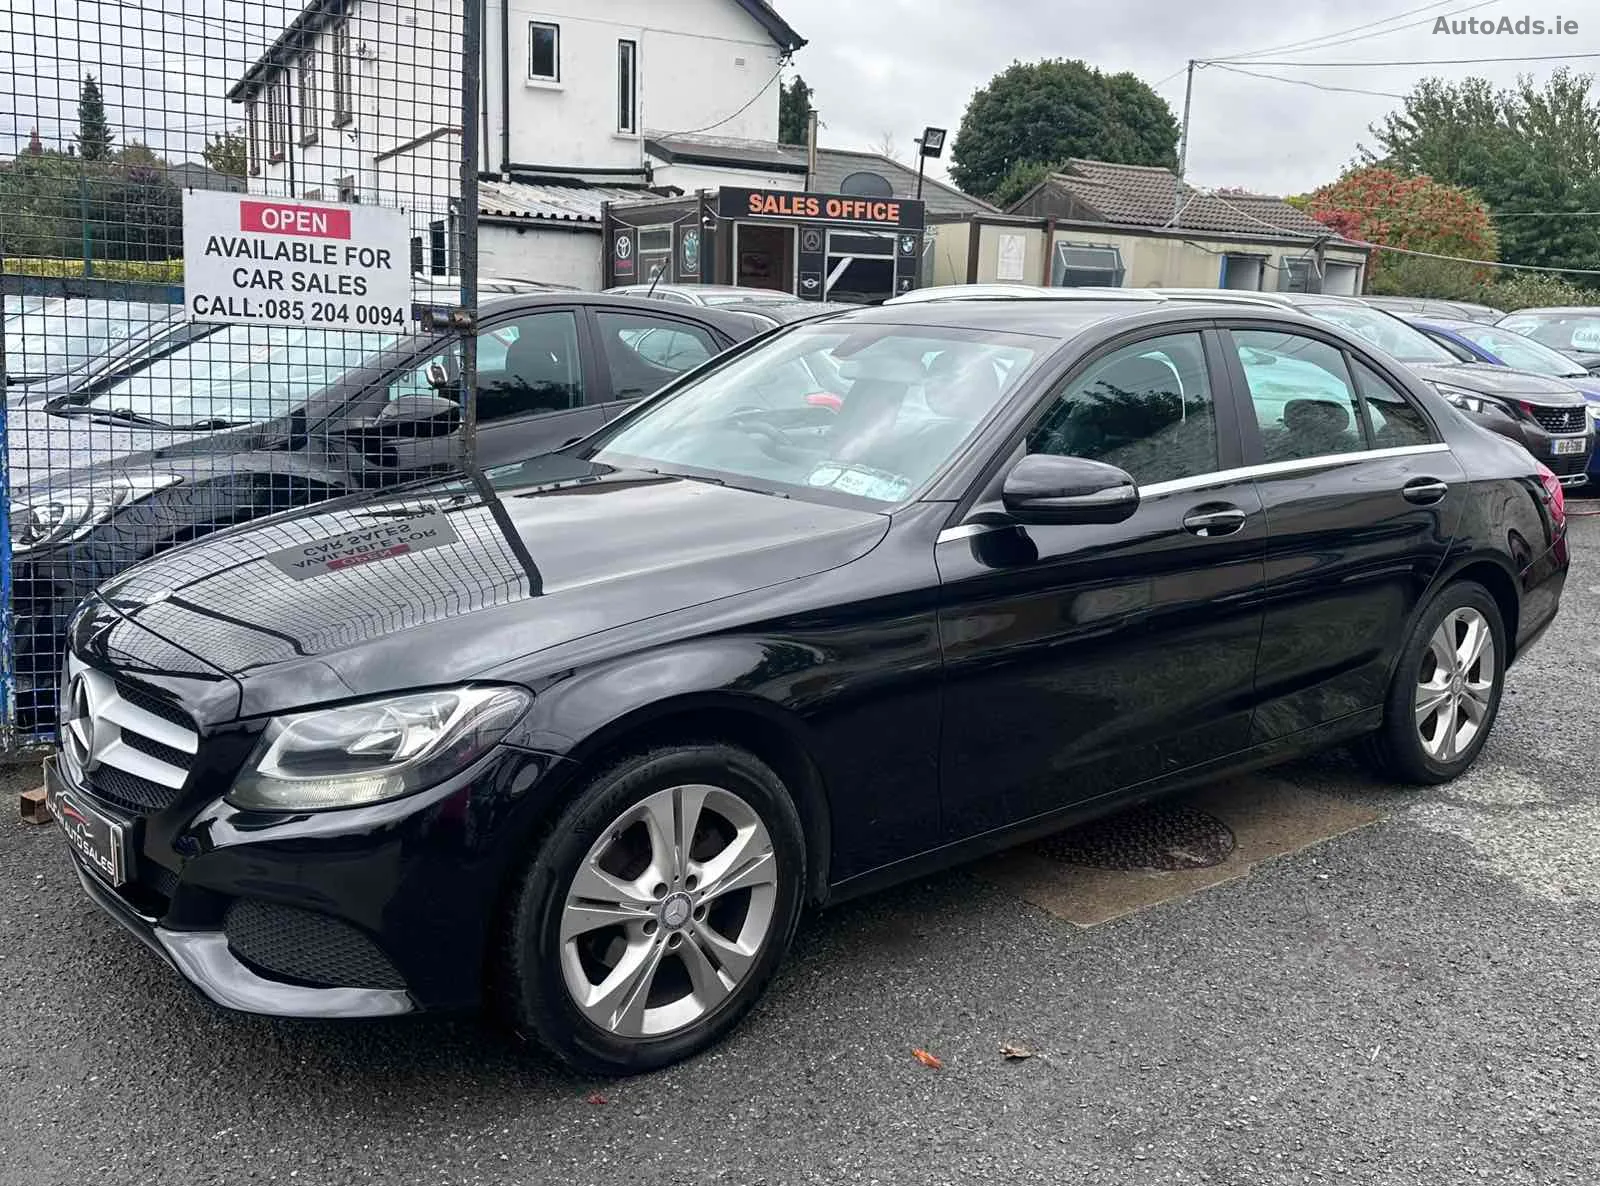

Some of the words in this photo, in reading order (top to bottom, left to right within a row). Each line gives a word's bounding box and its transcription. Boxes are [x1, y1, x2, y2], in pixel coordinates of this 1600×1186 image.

[261, 208, 328, 233] OPEN
[748, 193, 820, 217] SALES
[826, 198, 900, 222] OFFICE
[204, 235, 338, 265] AVAILABLE
[345, 246, 392, 269] FOR
[232, 267, 284, 291] CAR
[291, 271, 367, 296] SALES
[193, 295, 305, 320] CALL:085
[311, 302, 349, 323] 204
[356, 305, 404, 327] 0094
